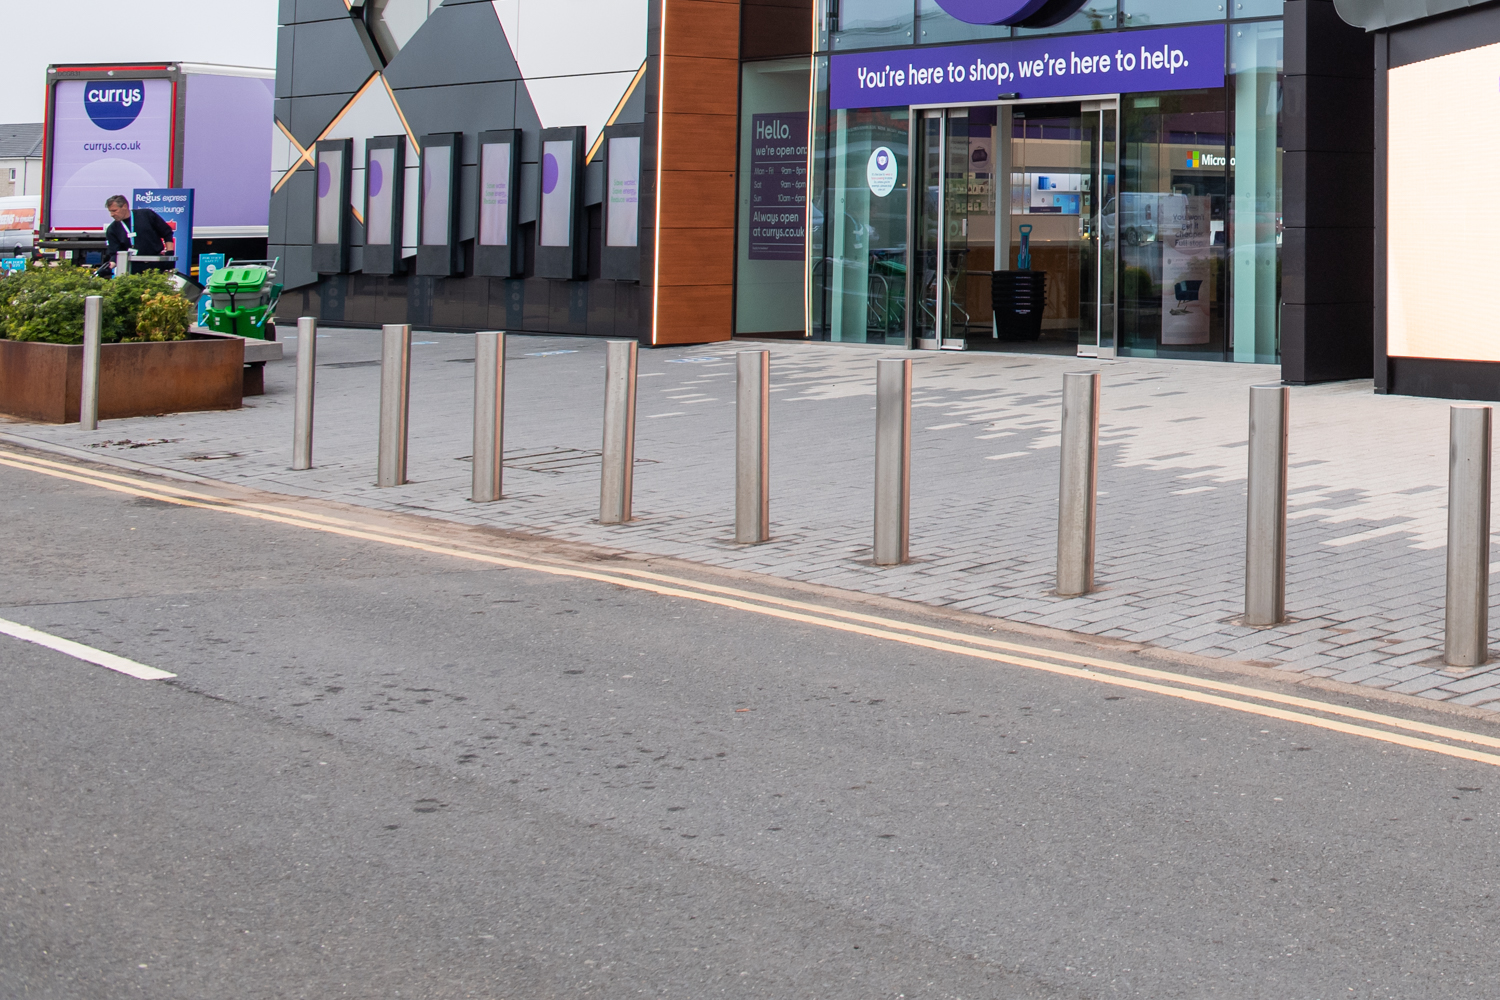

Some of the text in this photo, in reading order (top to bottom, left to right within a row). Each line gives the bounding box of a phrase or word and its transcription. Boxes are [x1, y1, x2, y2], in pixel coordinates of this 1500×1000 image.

[857, 44, 1189, 88] You're here to shop, we're here to help.
[88, 88, 141, 107] currys
[756, 120, 791, 139] Hello,
[83, 141, 141, 153] currys.co.uk
[756, 145, 775, 156] we're
[776, 147, 794, 158] open
[795, 180, 806, 189] 6pm
[135, 191, 187, 203] Regus express
[753, 194, 761, 202] Sun
[778, 194, 791, 202] 10am
[795, 194, 806, 203] 6pm
[163, 205, 185, 214] lounge
[753, 211, 799, 225] Always open
[753, 226, 805, 240] at currys.co.uk
